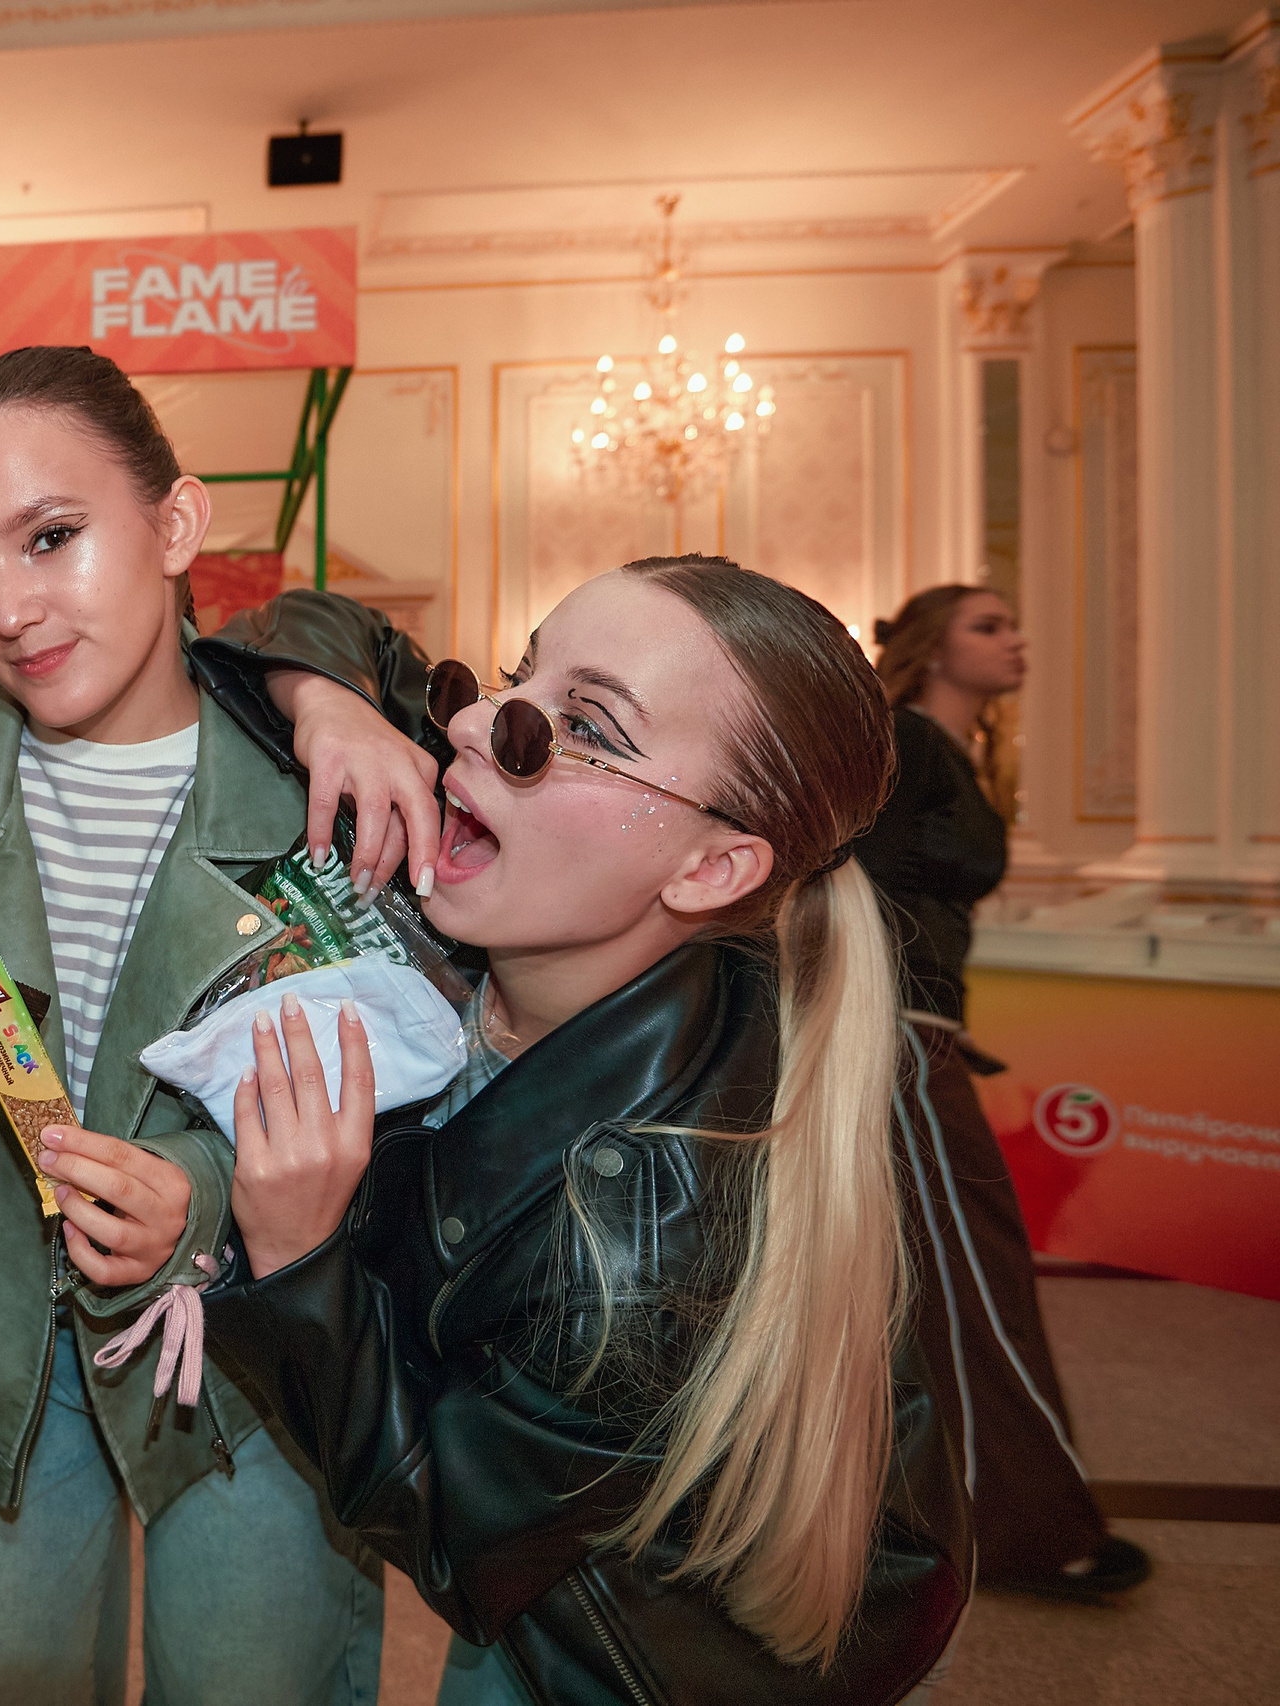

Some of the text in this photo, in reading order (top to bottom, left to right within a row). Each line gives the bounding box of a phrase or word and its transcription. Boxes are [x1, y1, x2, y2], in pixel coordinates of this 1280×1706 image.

[91, 261, 276, 302] FAME
[91, 295, 317, 339] FLAME
[322, 935, 331, 944] С
[3, 1024, 39, 1074] SNACK
